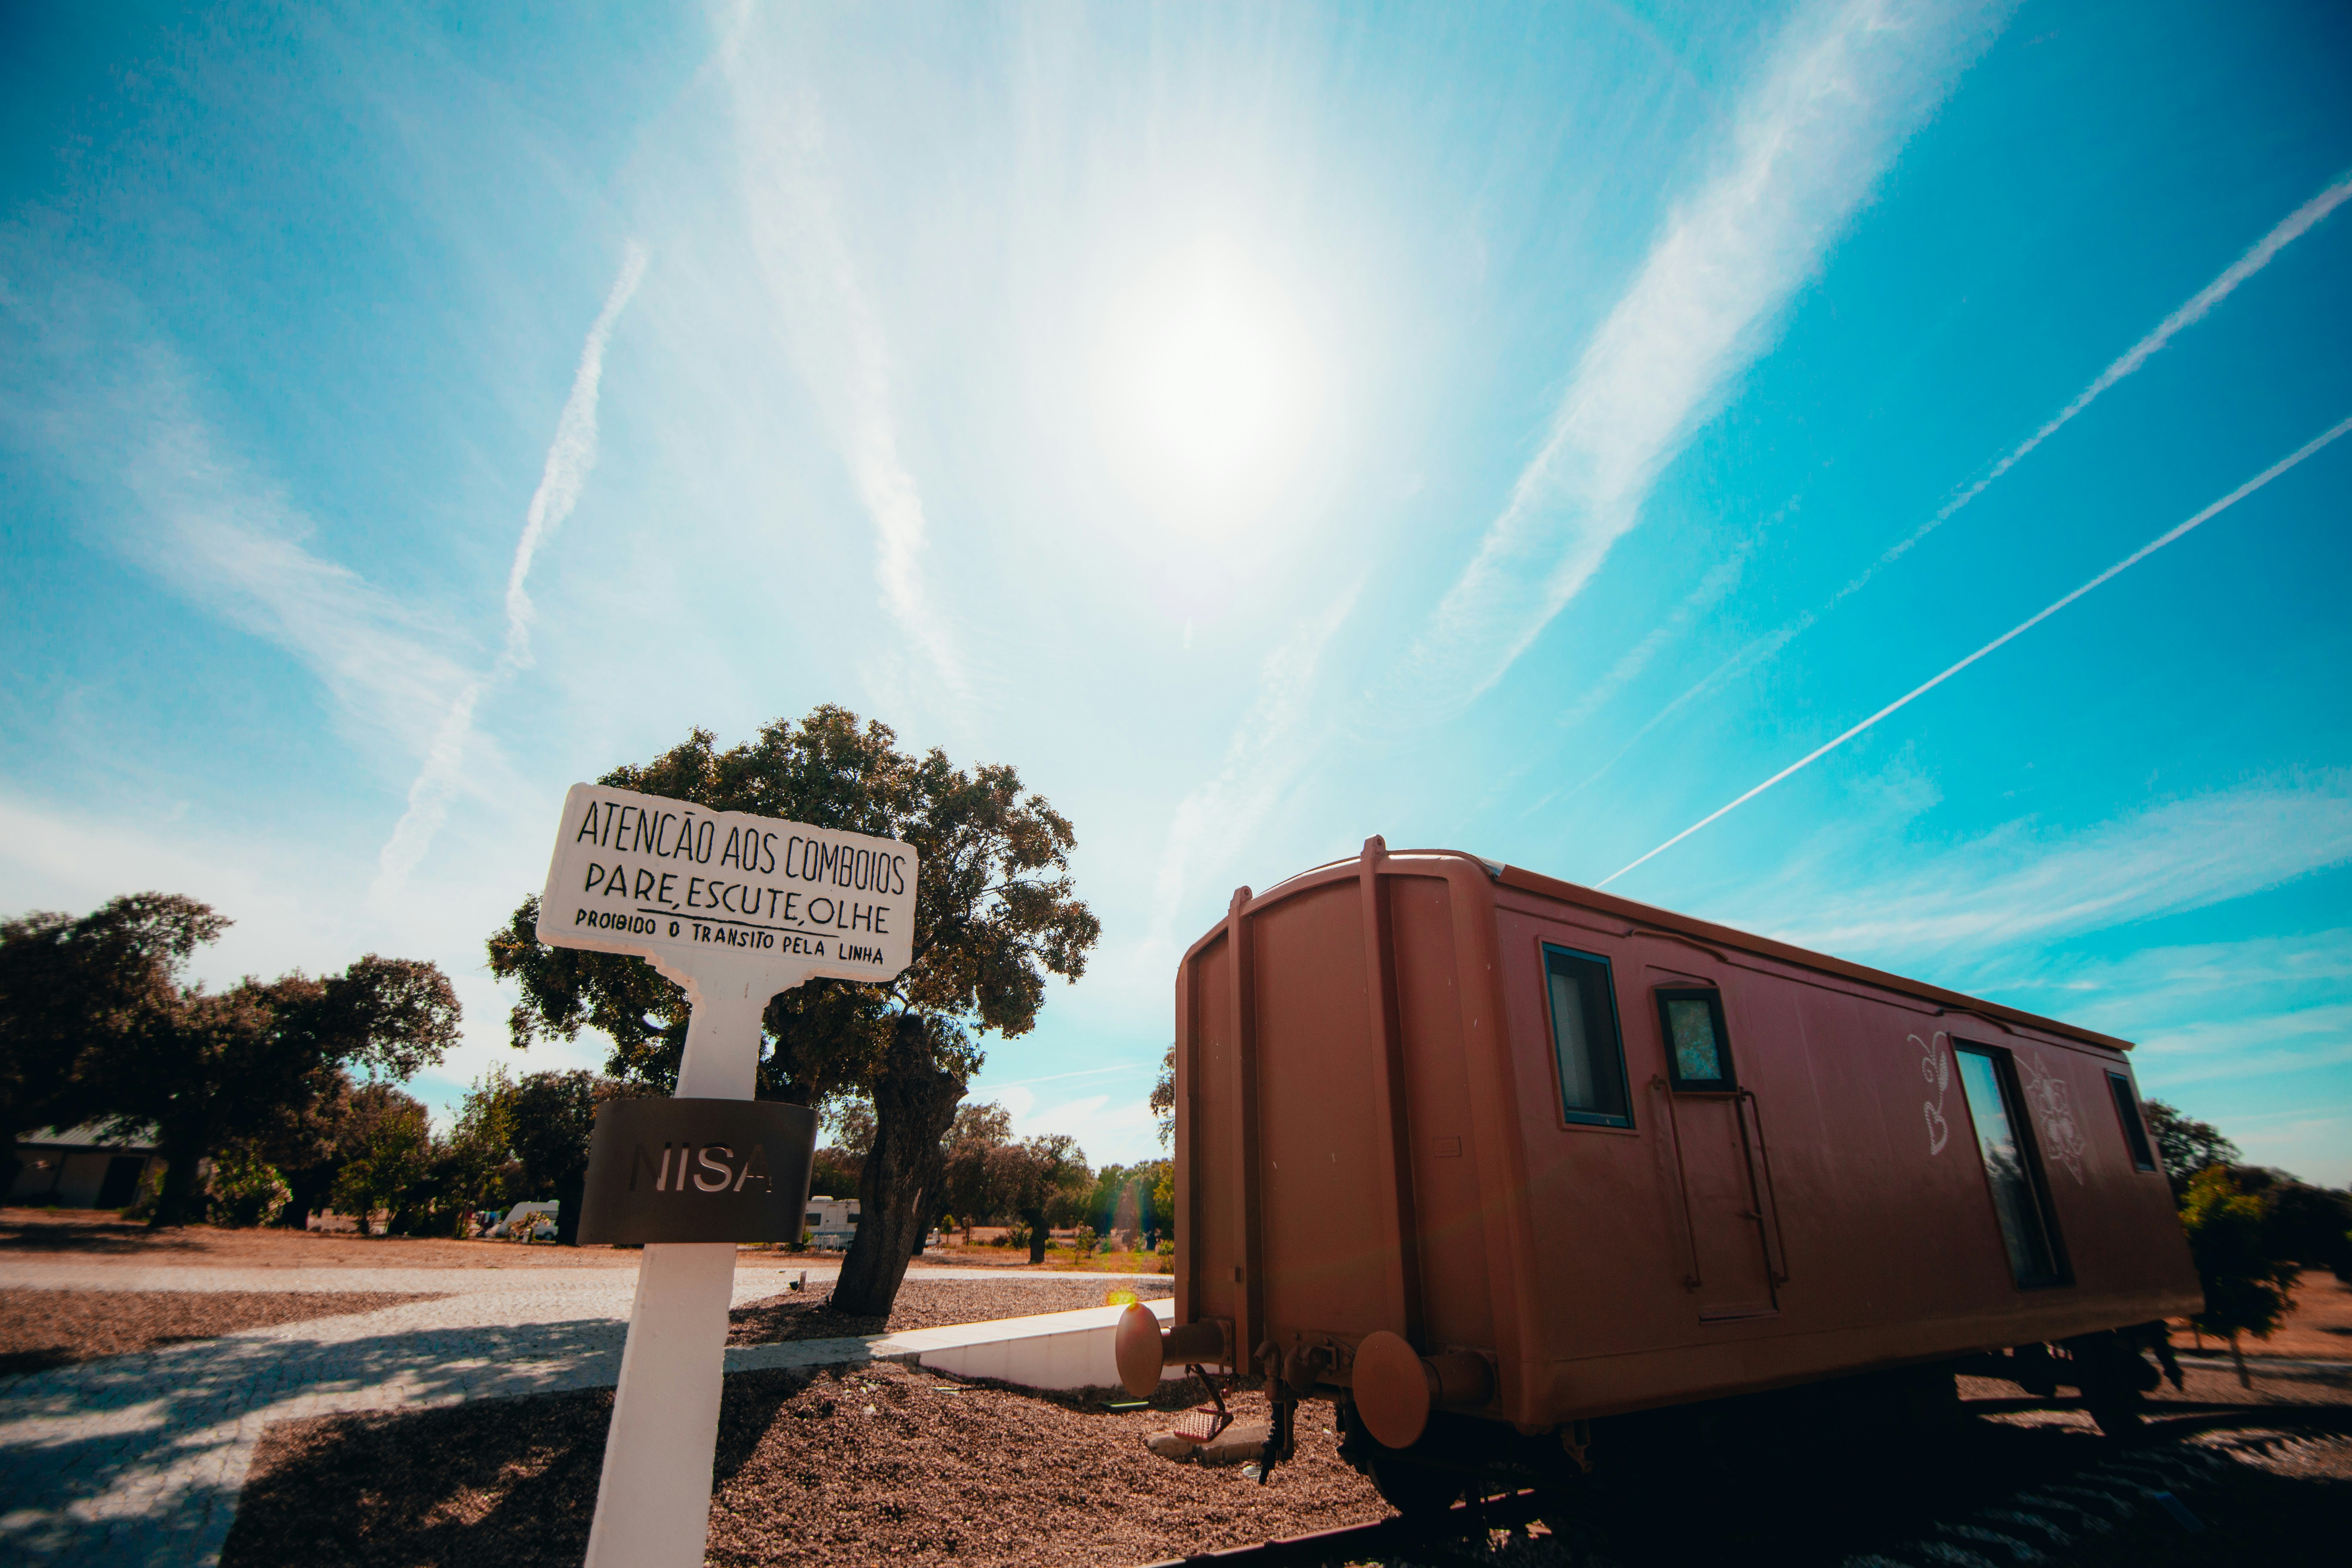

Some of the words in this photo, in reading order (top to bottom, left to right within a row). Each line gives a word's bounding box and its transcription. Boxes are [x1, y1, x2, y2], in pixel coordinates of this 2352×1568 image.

[721, 826, 778, 874] AOS
[786, 836, 905, 895] COMBOIOS
[575, 908, 656, 935] PROIBIDO
[669, 921, 680, 937] O
[692, 923, 774, 949] TRANSITO
[783, 937, 825, 956] PELA
[839, 943, 883, 965] LINHA
[629, 1142, 772, 1192] NISA
